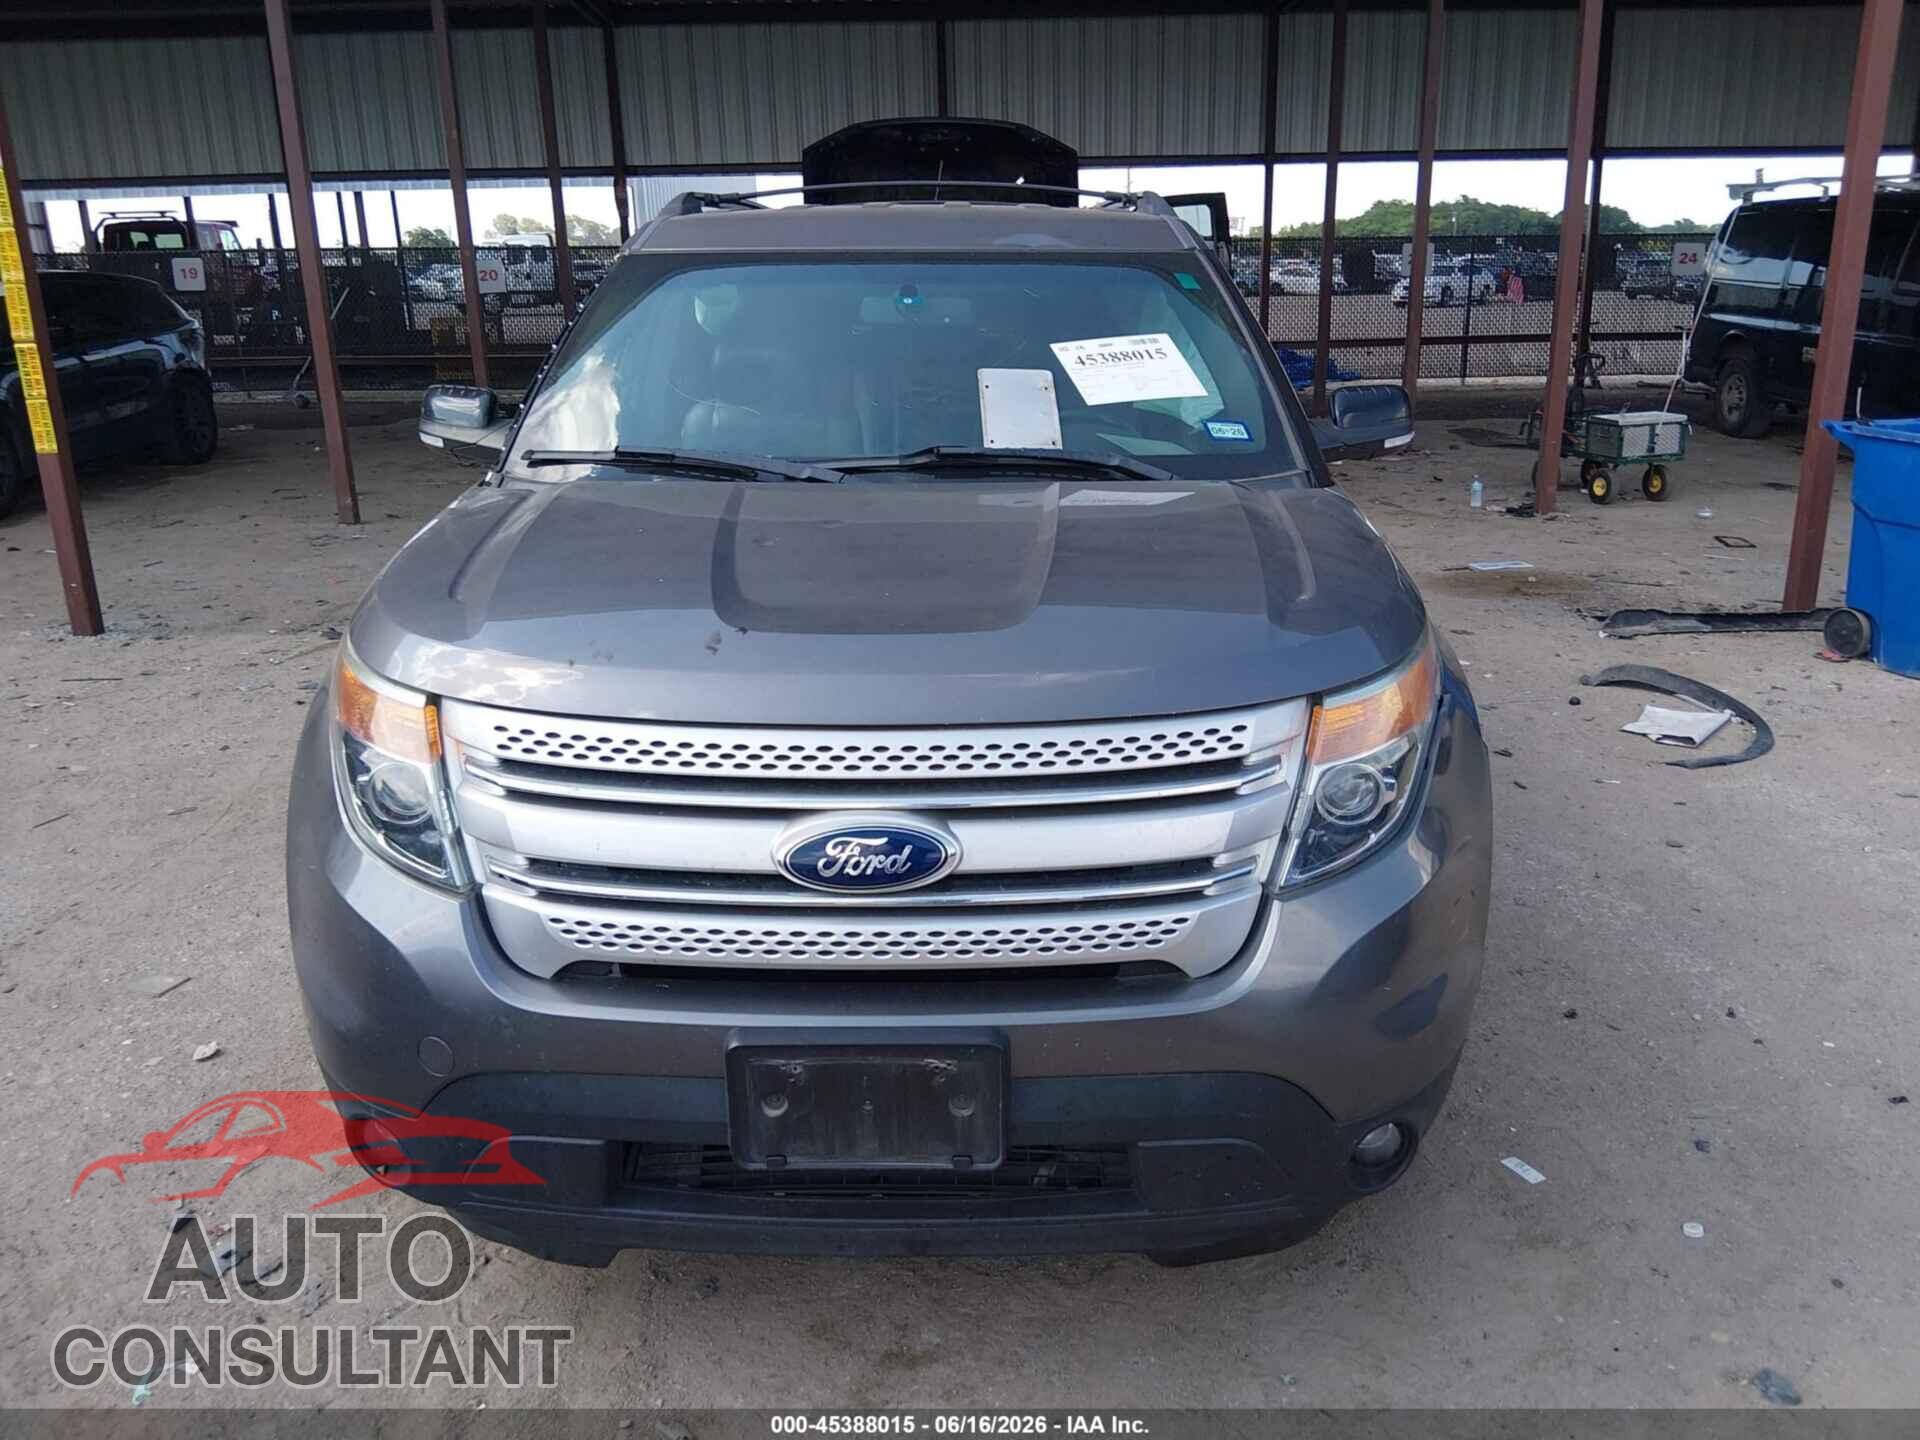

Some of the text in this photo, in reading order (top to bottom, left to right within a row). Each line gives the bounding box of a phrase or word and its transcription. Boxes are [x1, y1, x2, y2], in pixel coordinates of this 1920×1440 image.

[1680, 252, 1697, 265] 24
[180, 267, 198, 279] 19
[479, 270, 497, 281] 20
[1074, 347, 1168, 367] 45388015
[818, 837, 912, 877] Ford
